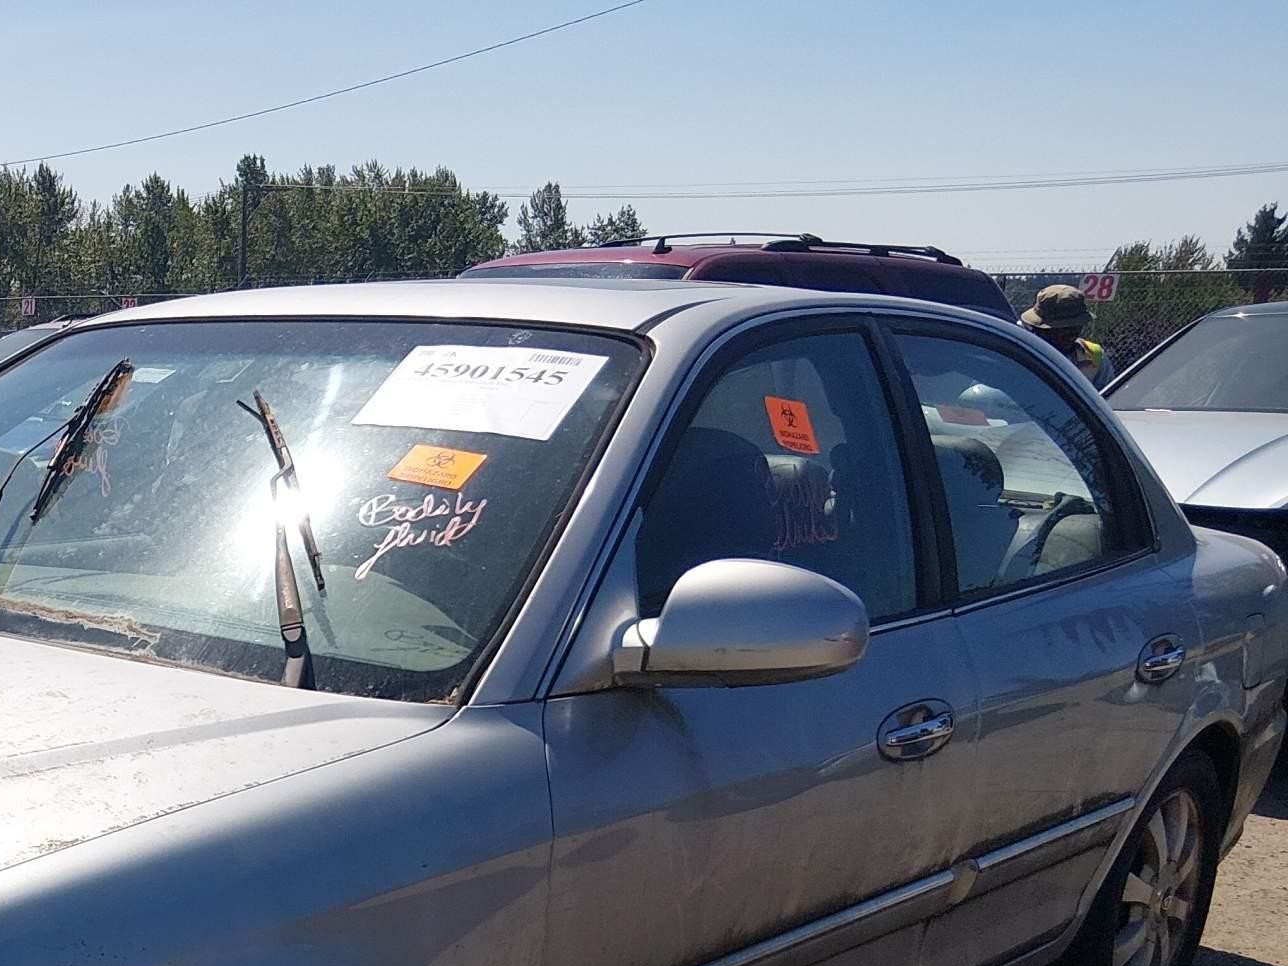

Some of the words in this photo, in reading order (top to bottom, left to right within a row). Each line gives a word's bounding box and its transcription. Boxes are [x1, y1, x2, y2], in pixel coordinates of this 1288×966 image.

[1084, 275, 1114, 300] 28
[23, 300, 32, 315] 21
[414, 362, 569, 386] 45901545
